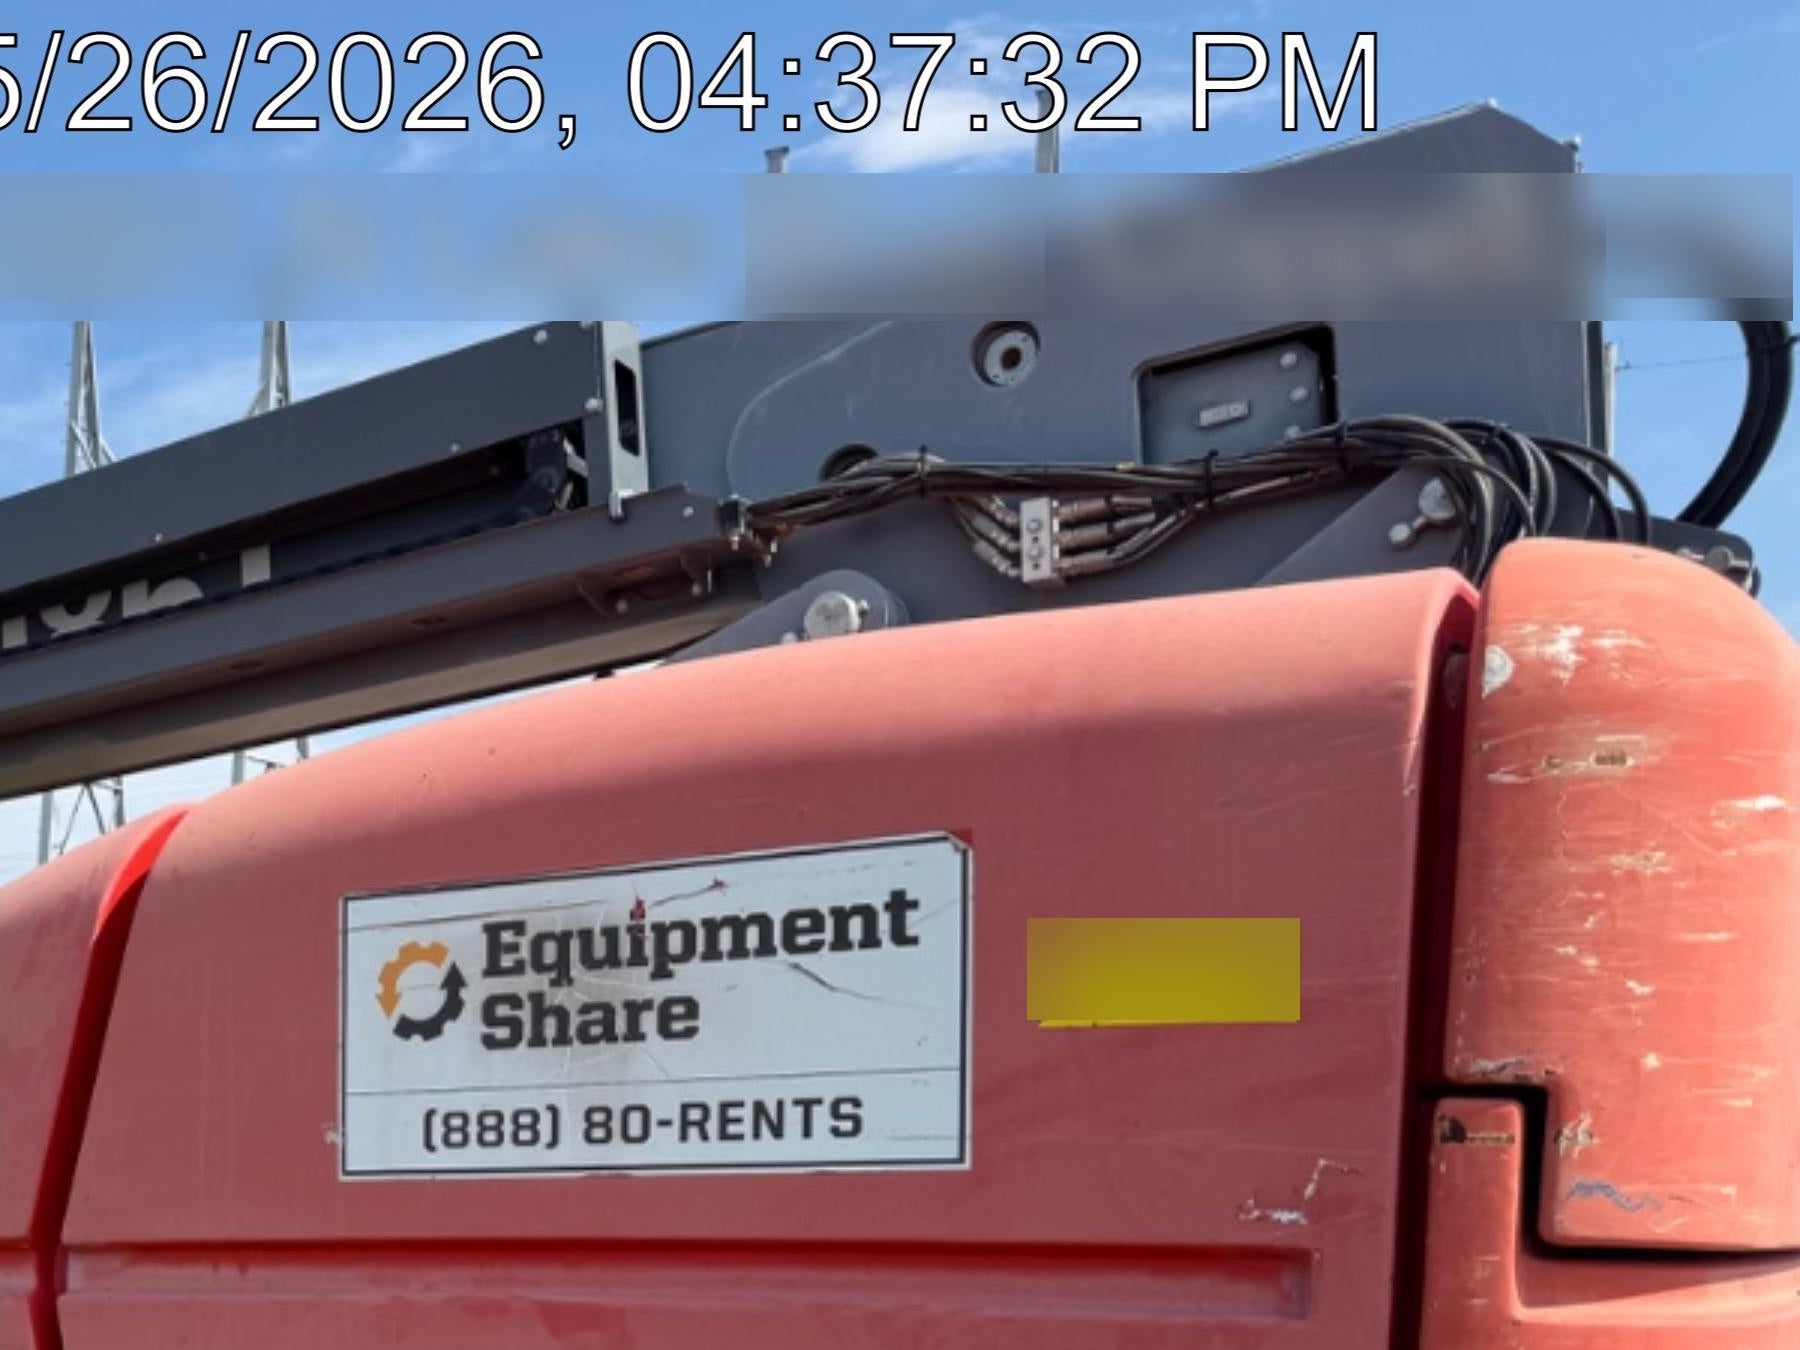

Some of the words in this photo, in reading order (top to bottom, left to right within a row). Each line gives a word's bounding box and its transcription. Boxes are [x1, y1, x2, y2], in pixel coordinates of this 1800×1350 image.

[482, 888, 920, 988] Equipment
[481, 991, 700, 1051] Share
[422, 1104, 560, 1154] (888)
[582, 1096, 864, 1146] 80-RENTS
